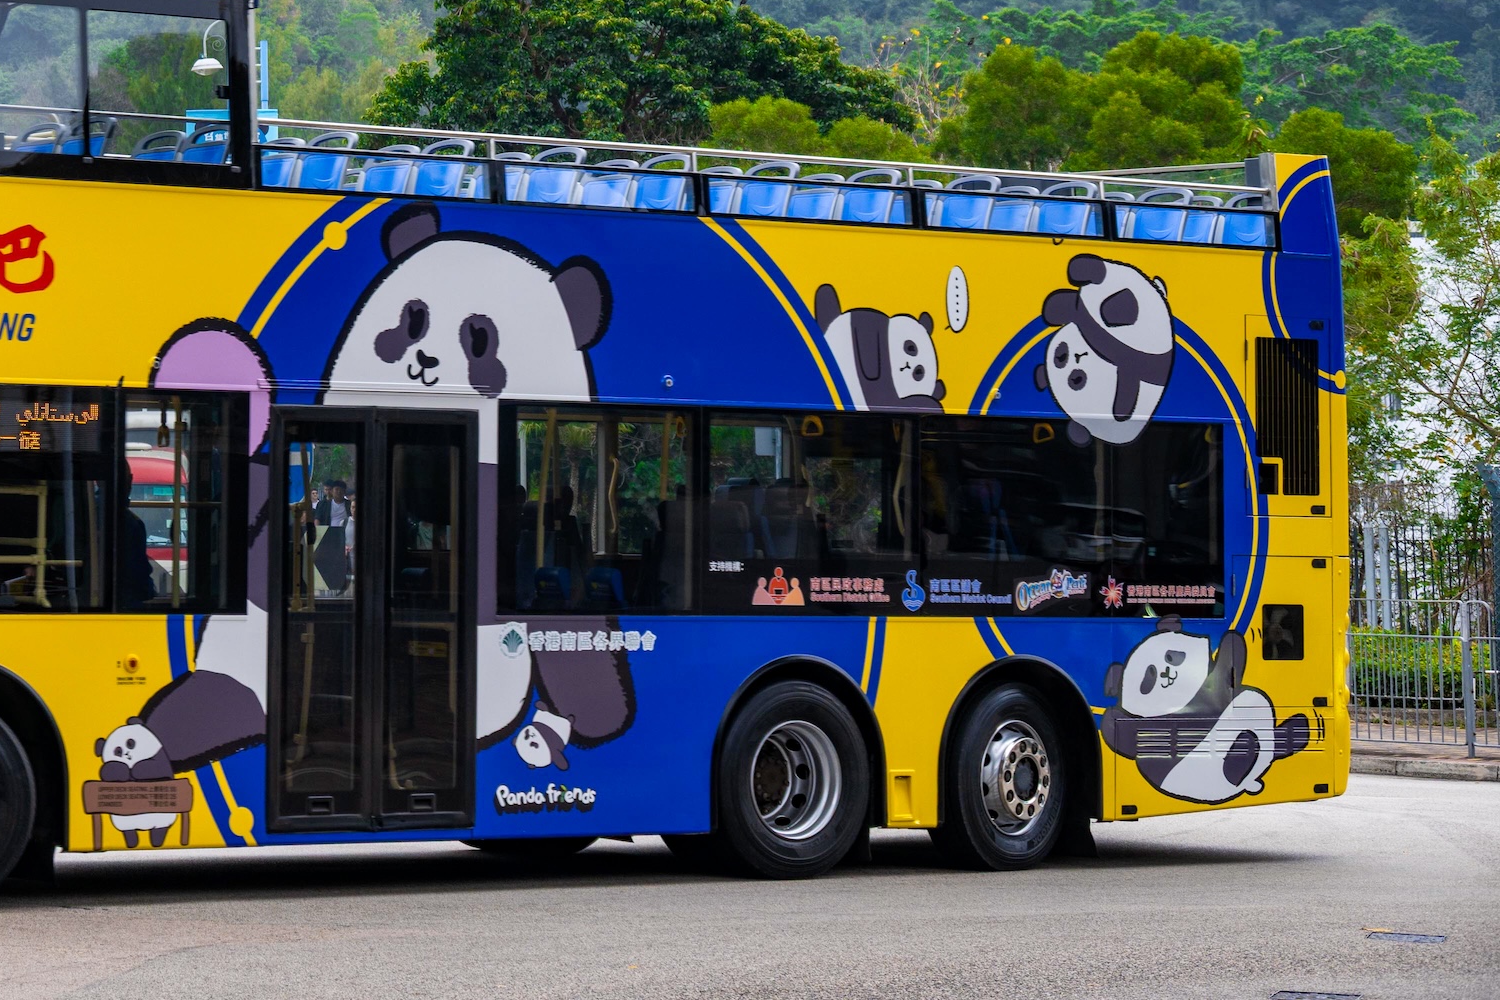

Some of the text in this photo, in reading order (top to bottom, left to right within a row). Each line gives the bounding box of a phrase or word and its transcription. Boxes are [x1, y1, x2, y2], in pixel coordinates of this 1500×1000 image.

[809, 592, 890, 602] Southern District Office
[929, 594, 1012, 604] Southern District Council
[1015, 579, 1052, 611] Ocean
[528, 630, 657, 651] 香港南區各界聯會
[495, 783, 597, 811] Panda friends
